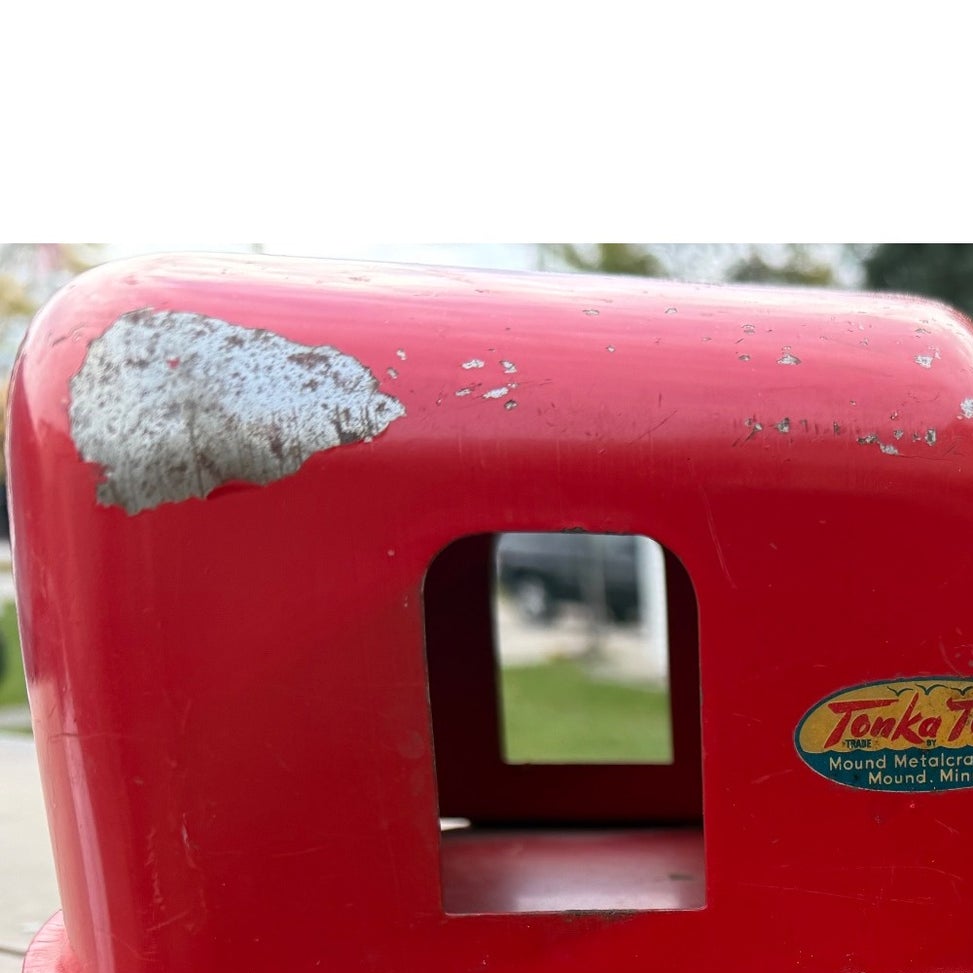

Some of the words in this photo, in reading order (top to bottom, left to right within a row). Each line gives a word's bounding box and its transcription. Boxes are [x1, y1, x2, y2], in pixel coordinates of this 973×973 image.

[823, 692, 943, 749] Tonka
[845, 738, 872, 749] TRADE
[829, 754, 887, 771] Mound
